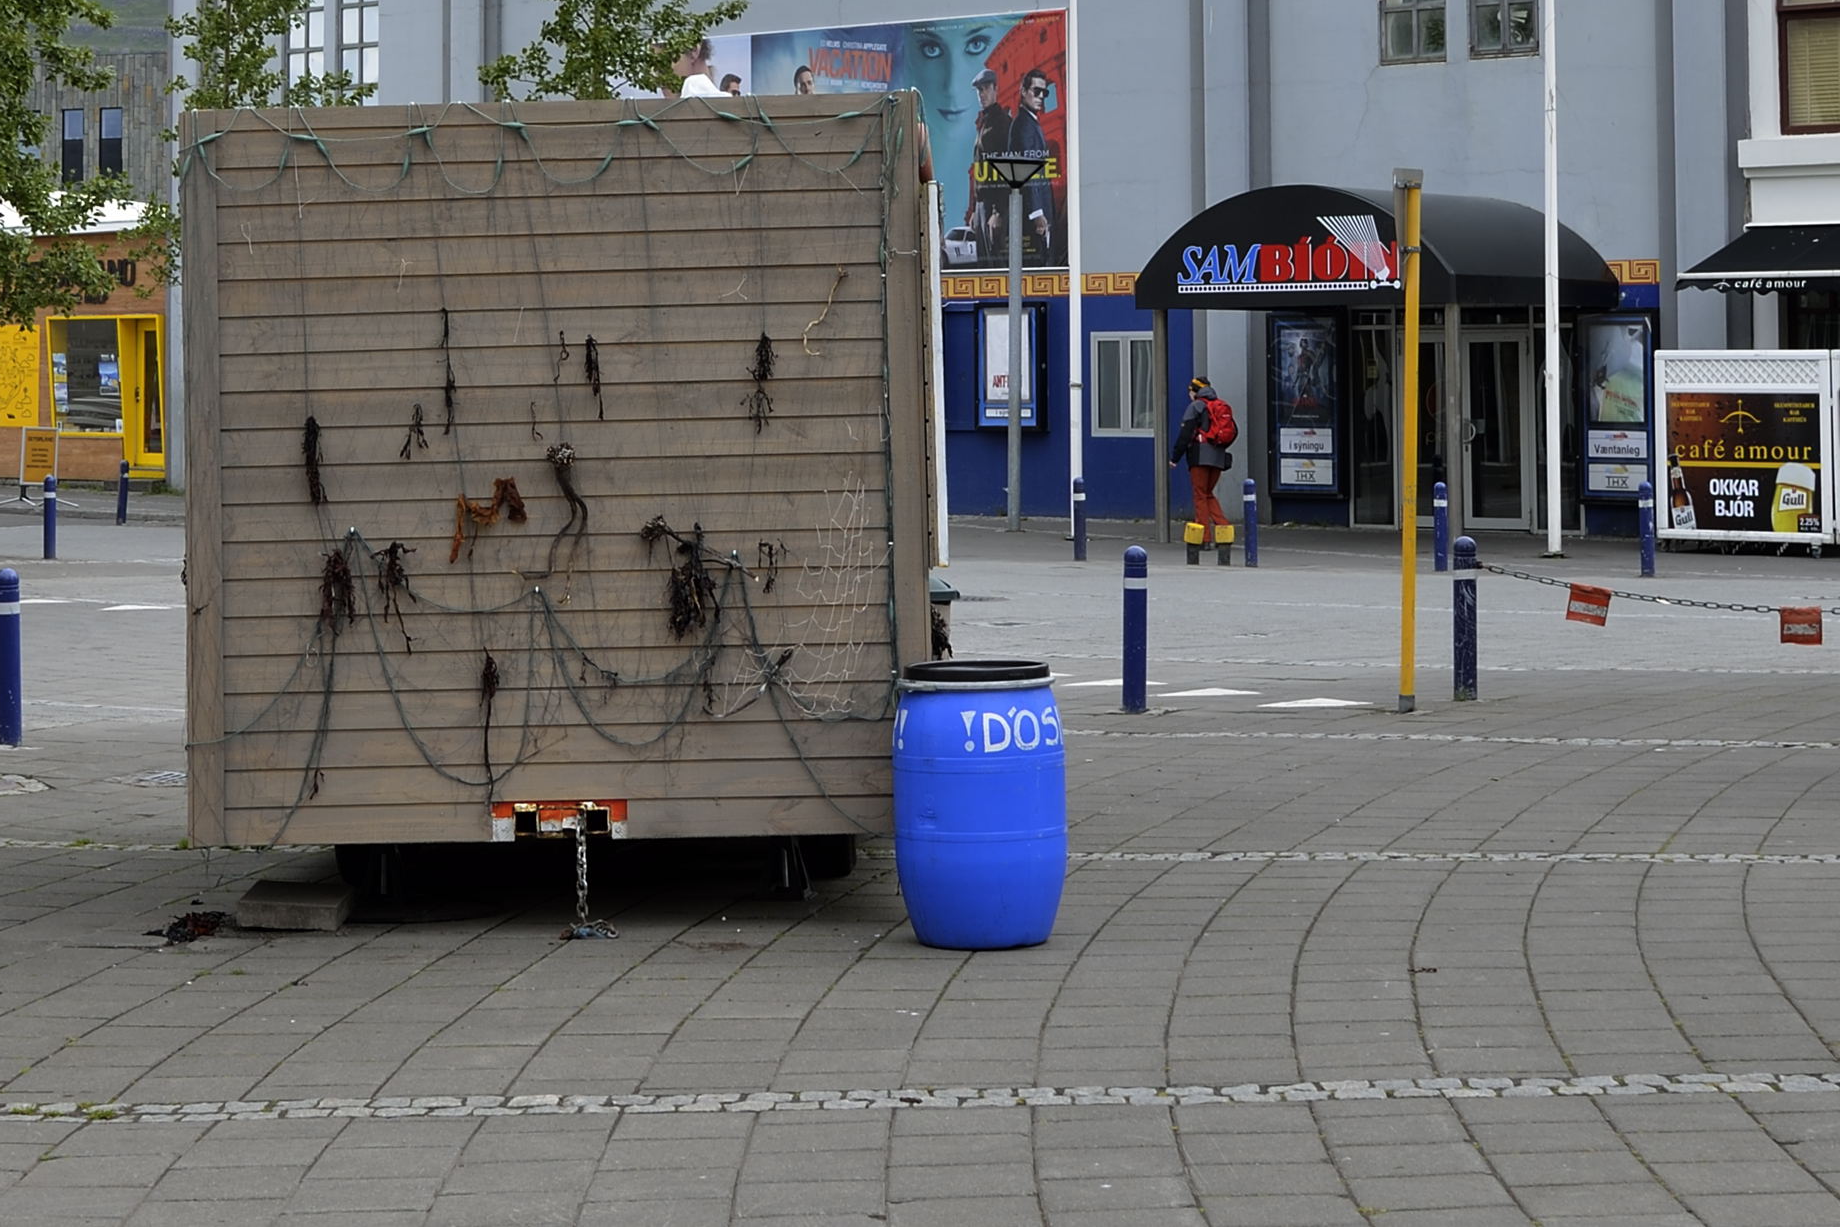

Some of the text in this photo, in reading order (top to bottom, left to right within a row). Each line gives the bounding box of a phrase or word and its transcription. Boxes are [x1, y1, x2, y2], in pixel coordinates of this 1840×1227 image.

[808, 46, 892, 82] VACATION
[1024, 150, 1049, 158] FROM
[1734, 278, 1807, 288] café amour
[1294, 441, 1324, 452] sýningu
[1594, 444, 1640, 456] Væntanleg
[1675, 439, 1812, 460] café amour
[1295, 470, 1316, 483] THX
[1605, 476, 1629, 488] THX
[1709, 479, 1759, 496] OKKAR
[1715, 495, 1754, 517] BJÓR
[1782, 493, 1804, 506] Gull
[1675, 511, 1693, 526] Gull
[1800, 518, 1820, 526] 2.25%
